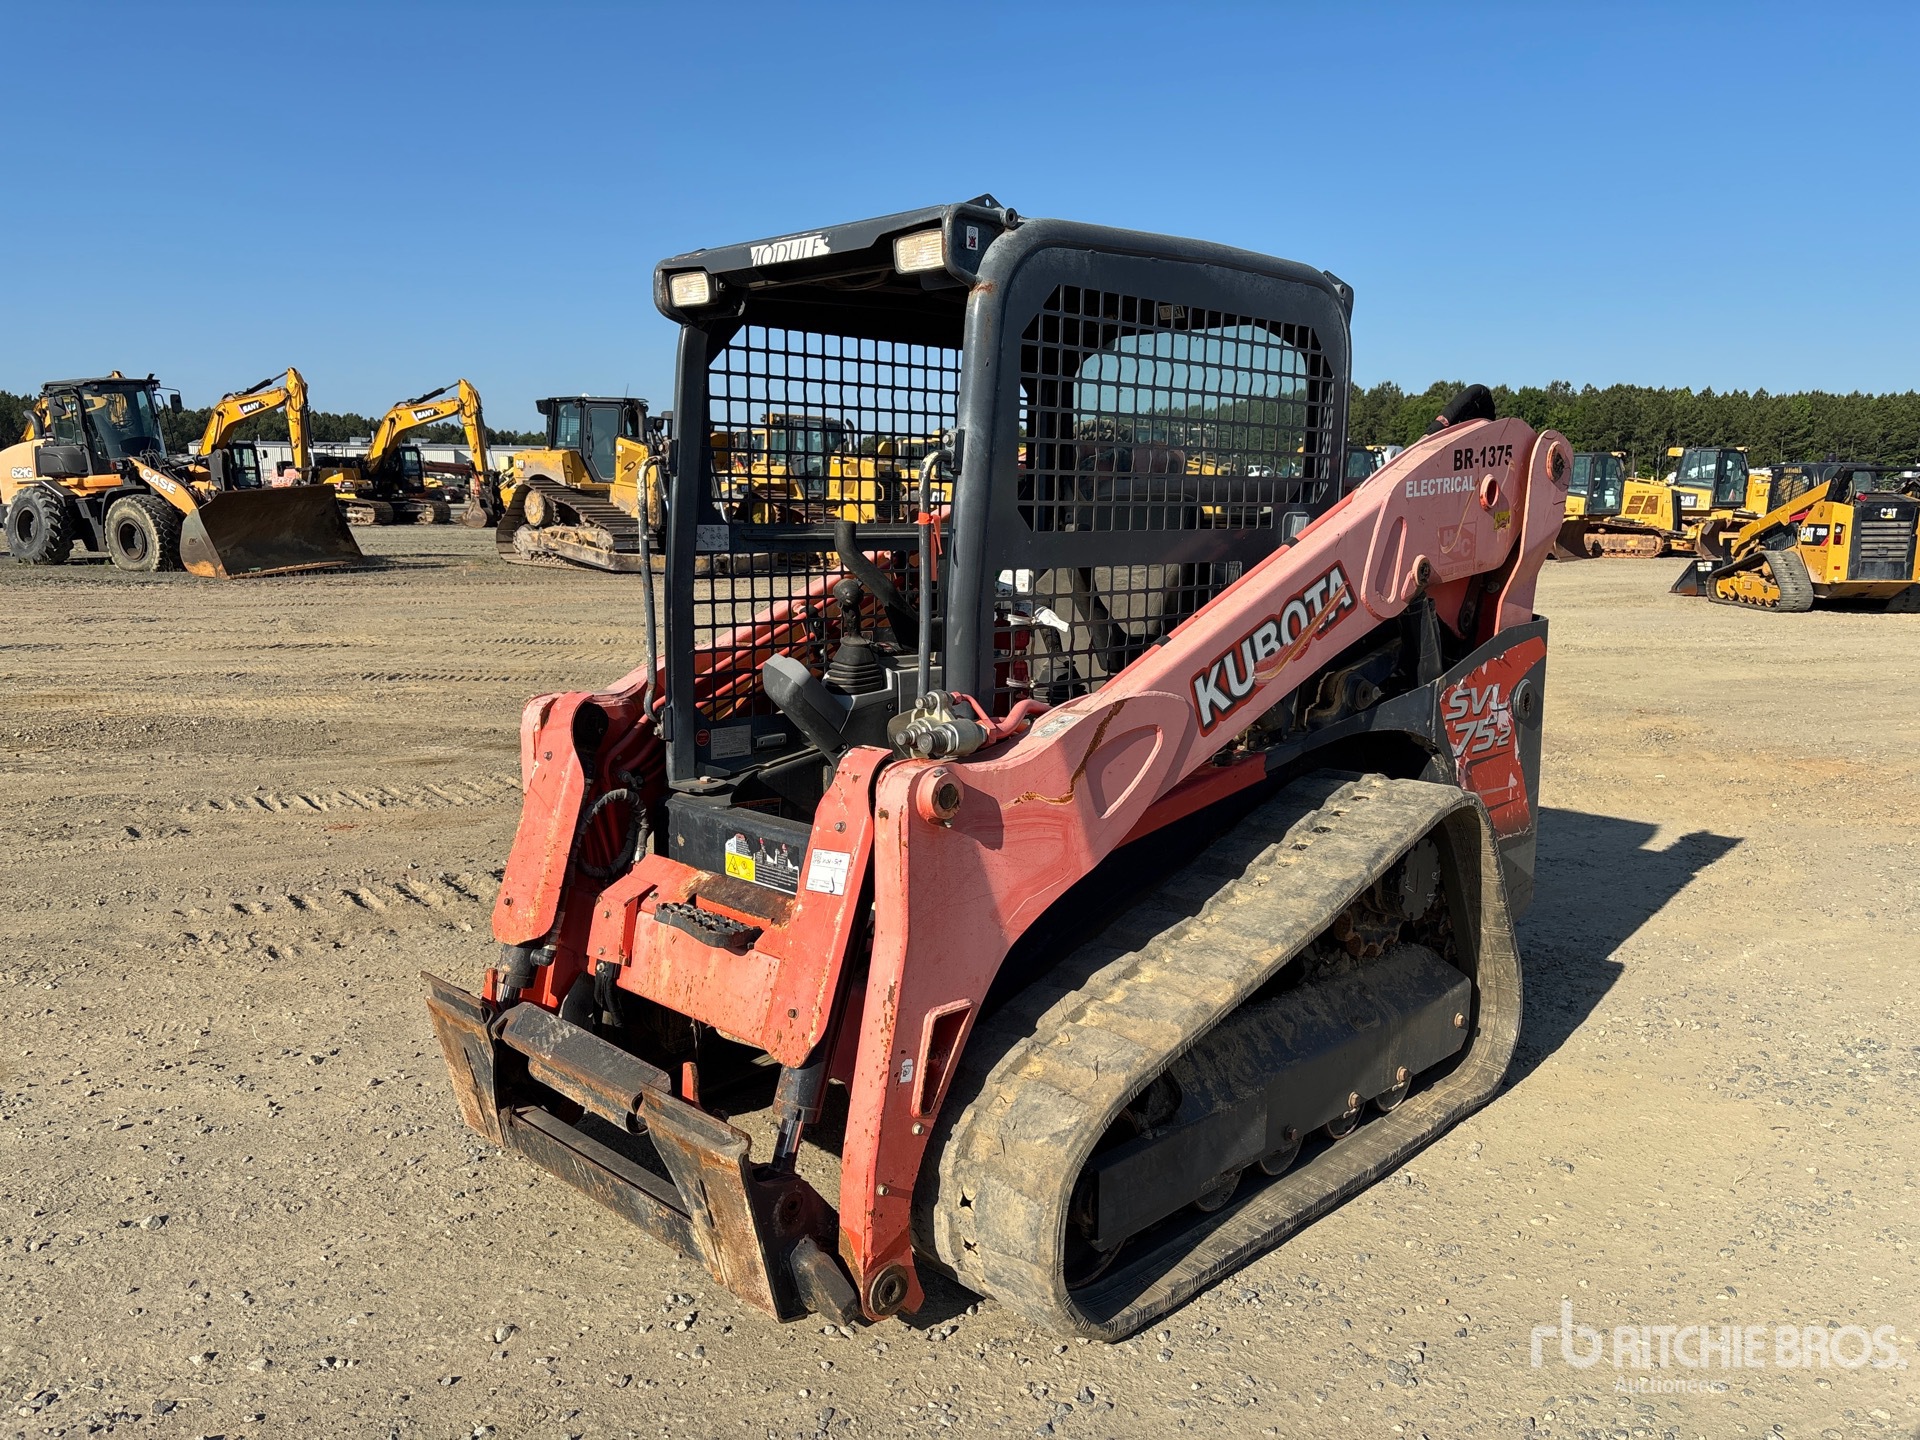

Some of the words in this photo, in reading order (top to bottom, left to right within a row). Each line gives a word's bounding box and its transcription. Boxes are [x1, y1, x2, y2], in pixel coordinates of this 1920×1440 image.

[242, 401, 260, 413] SANY
[416, 409, 434, 420] SANY
[1453, 444, 1512, 471] BR-1375
[11, 467, 33, 479] 621G
[142, 468, 177, 495] CASE
[1405, 475, 1475, 498] ELECTRICAL
[1880, 507, 1898, 519] CAT
[1800, 526, 1815, 542] CAT
[1193, 566, 1352, 728] KUBOTA
[1445, 683, 1509, 720] SVL
[1453, 718, 1512, 758] 75-2
